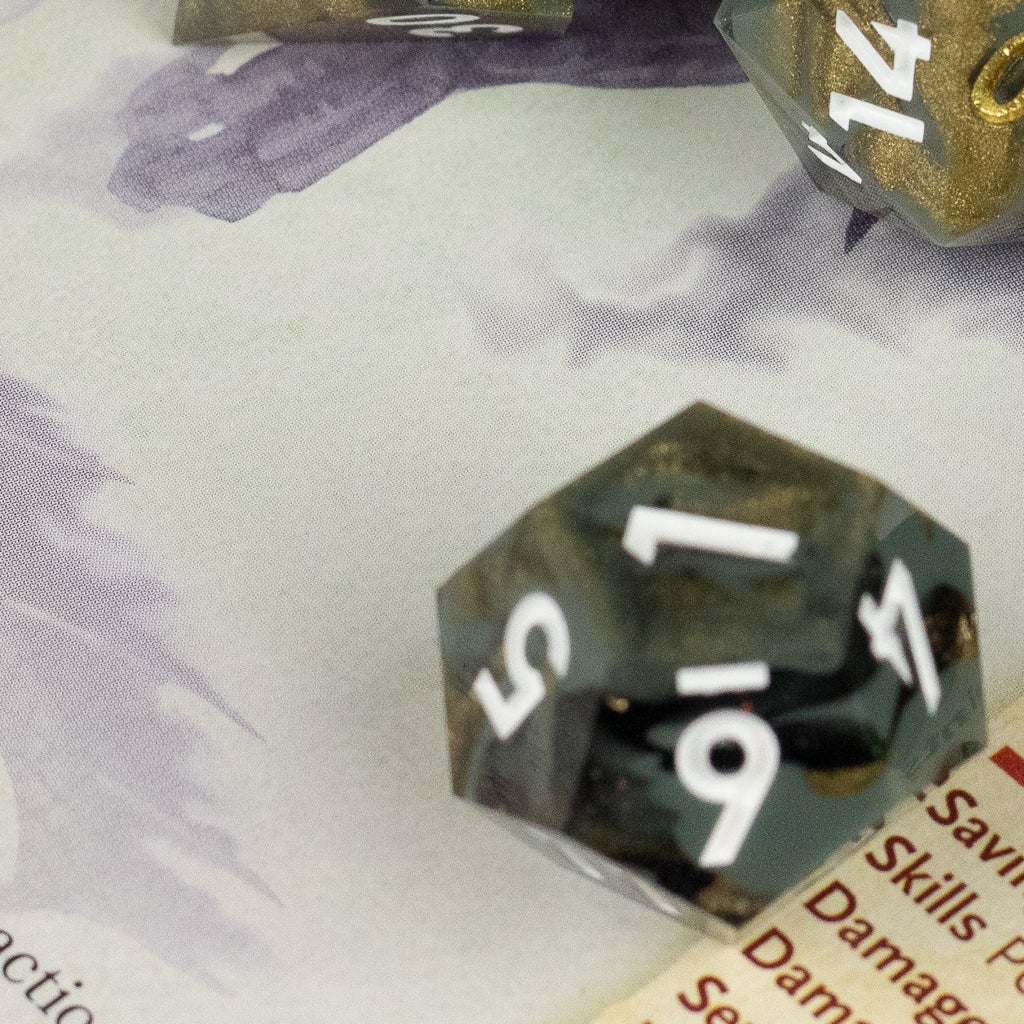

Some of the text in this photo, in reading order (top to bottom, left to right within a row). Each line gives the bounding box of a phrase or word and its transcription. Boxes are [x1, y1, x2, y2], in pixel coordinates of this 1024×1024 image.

[828, 9, 932, 143] 14
[622, 505, 799, 566] 1
[473, 590, 571, 742] 5
[857, 558, 942, 715] 4
[864, 834, 988, 942] Skills
